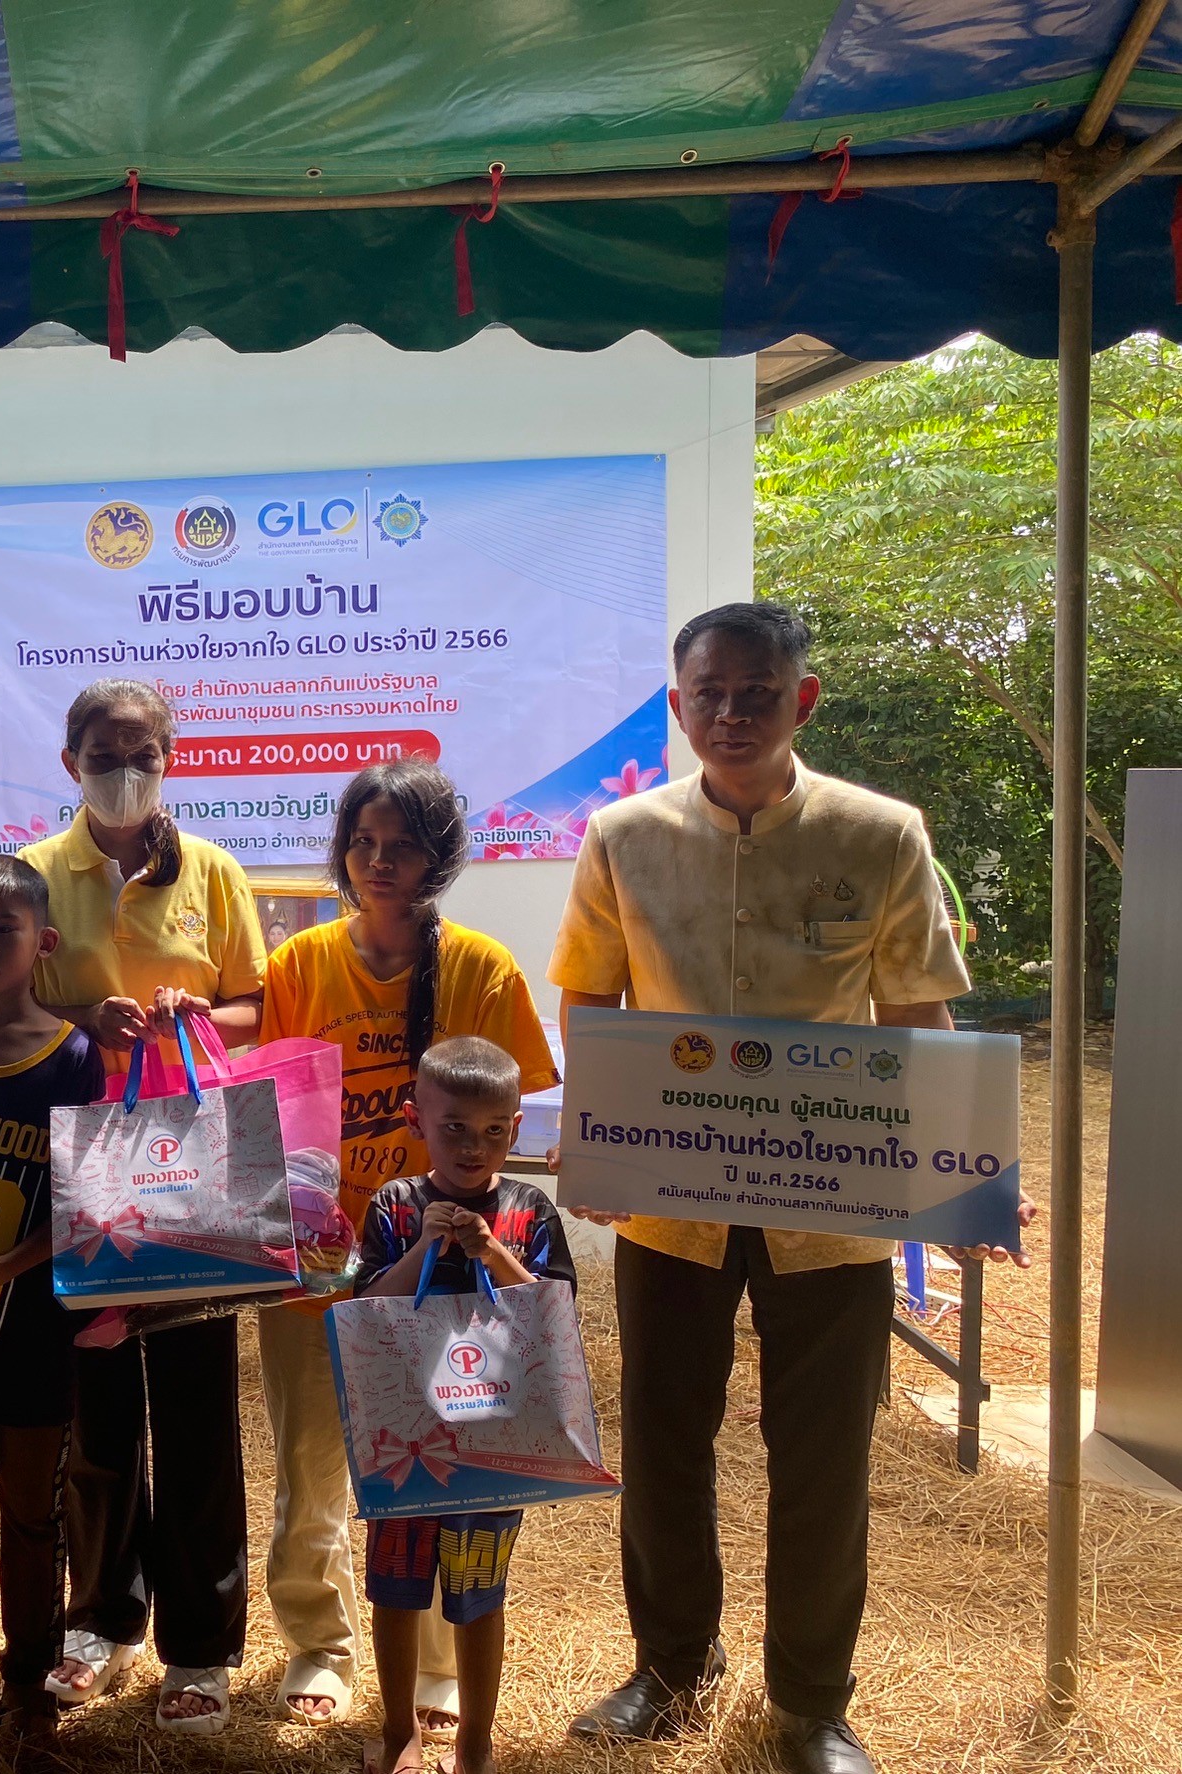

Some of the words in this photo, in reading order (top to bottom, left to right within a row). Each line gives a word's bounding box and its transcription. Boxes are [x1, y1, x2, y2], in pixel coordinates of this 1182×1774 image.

[258, 498, 358, 538] GLO
[171, 544, 241, 568] กรมการพัฒนาชุมชน
[271, 549, 311, 557] GOVERNMENT
[137, 574, 379, 623] พิธีมอบบ้าน
[17, 631, 290, 666] โครงการบ้านห่วงใยจากใจ
[296, 634, 346, 655] GLO
[353, 626, 437, 653] ประจำปี
[444, 628, 509, 650] 2566
[191, 673, 438, 697] สำนักงานสลากกินแบ่งรัฐบาล
[170, 702, 295, 725] ารพัฒนาชุมชน
[300, 693, 458, 718] กระทรวงมหาดไทย
[171, 748, 241, 767] ระมาณ
[248, 742, 349, 766] 200,000
[356, 741, 402, 762] บาท
[209, 835, 267, 850] องยาว
[311, 1017, 343, 1040] INTAGE
[345, 1010, 374, 1023] SPEED
[377, 1010, 408, 1020] AUTHE
[433, 1021, 449, 1036] QU
[787, 1043, 854, 1070] GLO
[661, 1089, 780, 1119] ขอขอบคุณ
[790, 1093, 911, 1130] ผู้สนับสนุน
[579, 1112, 919, 1170] โครงการบ้านห่วงใยจากใจ
[932, 1149, 1001, 1177] GLO
[349, 1145, 408, 1175] 1989
[131, 1167, 200, 1186] พวงทอง
[138, 1182, 194, 1196] สรรพสินค้า
[723, 1163, 739, 1183] ปี
[746, 1170, 841, 1192] พ.ศ.2566
[657, 1184, 732, 1203] สนับสนุนโดย
[736, 1191, 910, 1220] สำนักงานสลากกินแบ่งรัฐบาล
[435, 1379, 511, 1400] พวงทอง
[445, 1396, 506, 1412] สรรพสินค้า
[507, 1489, 547, 1500] 038-552299
